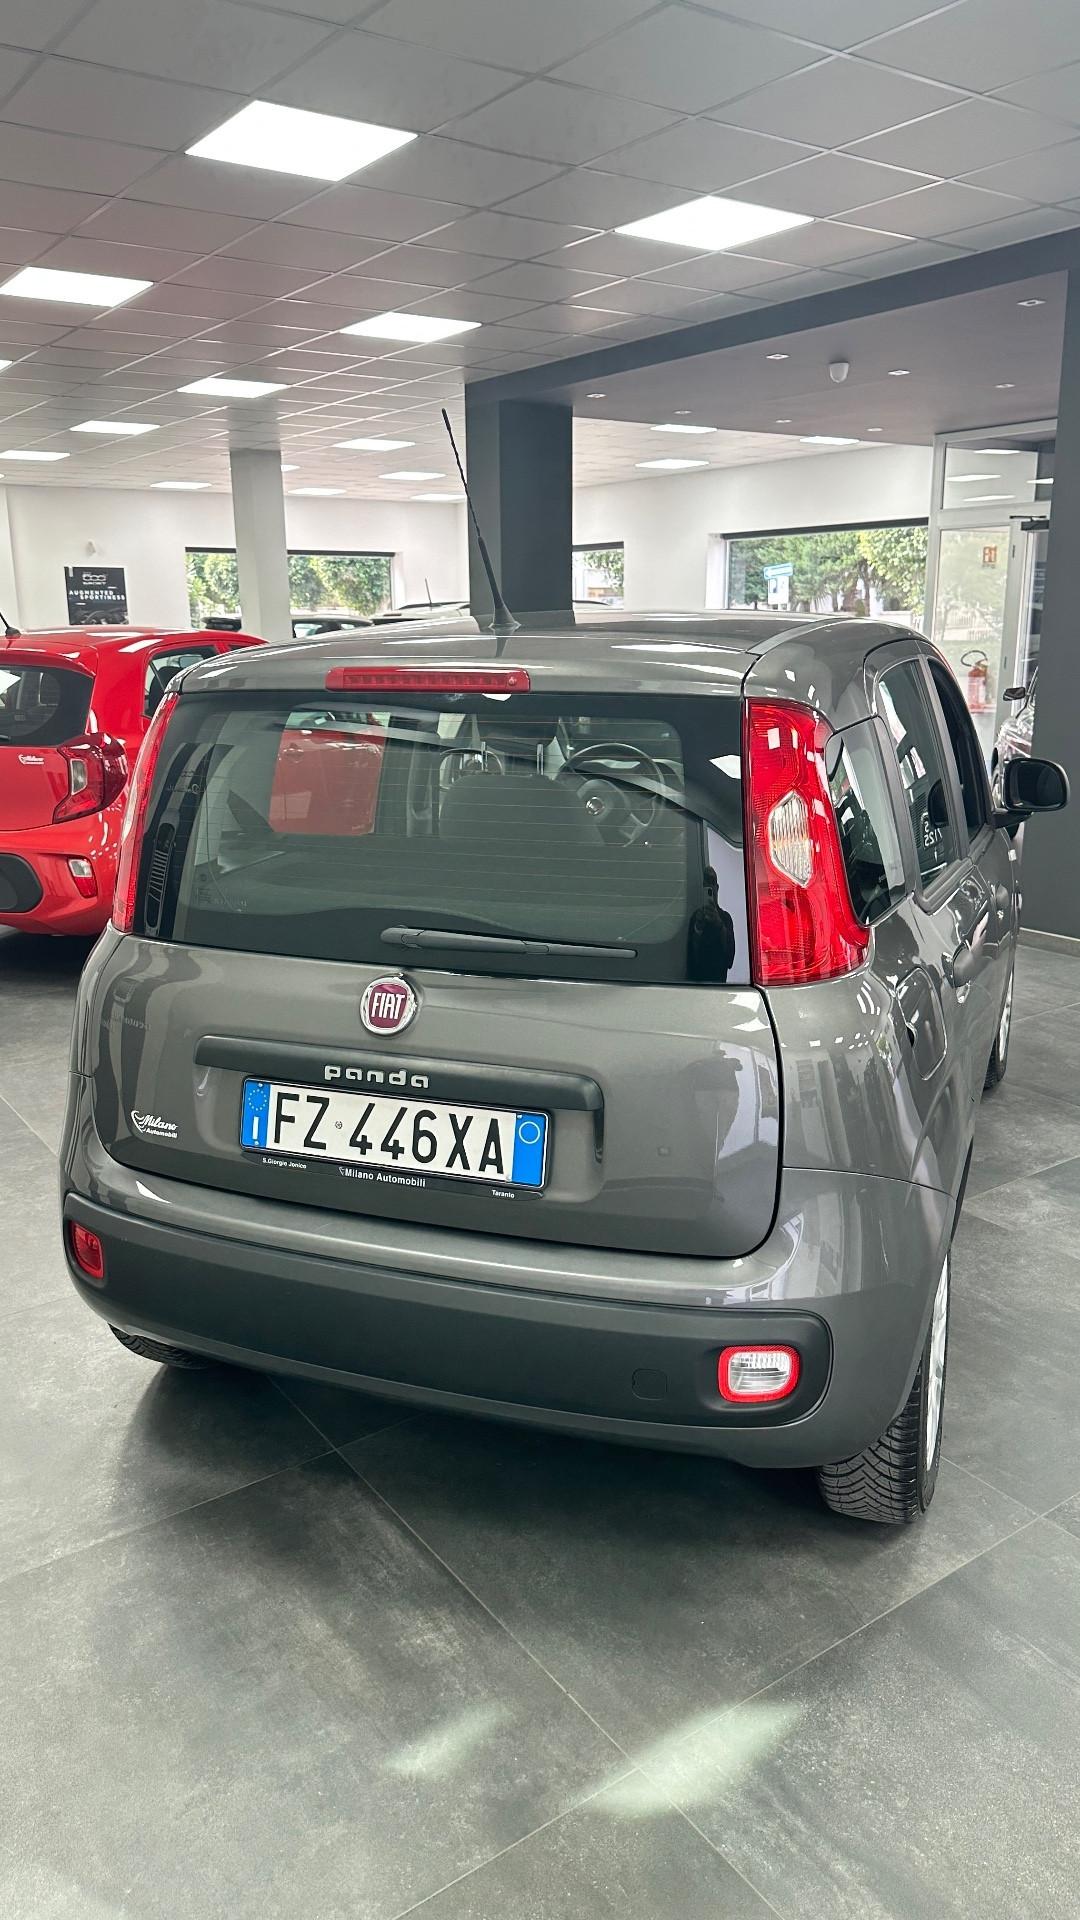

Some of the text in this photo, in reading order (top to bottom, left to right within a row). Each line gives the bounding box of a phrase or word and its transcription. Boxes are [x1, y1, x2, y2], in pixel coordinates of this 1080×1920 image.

[371, 992, 406, 1020] FIAT
[324, 1064, 429, 1089] panda
[138, 1115, 179, 1130] Milano
[274, 1091, 505, 1175] FZ 446XA
[145, 1128, 178, 1139] Automobili
[344, 1167, 426, 1188] Milano Automobili
[491, 1189, 515, 1198] Taranto
